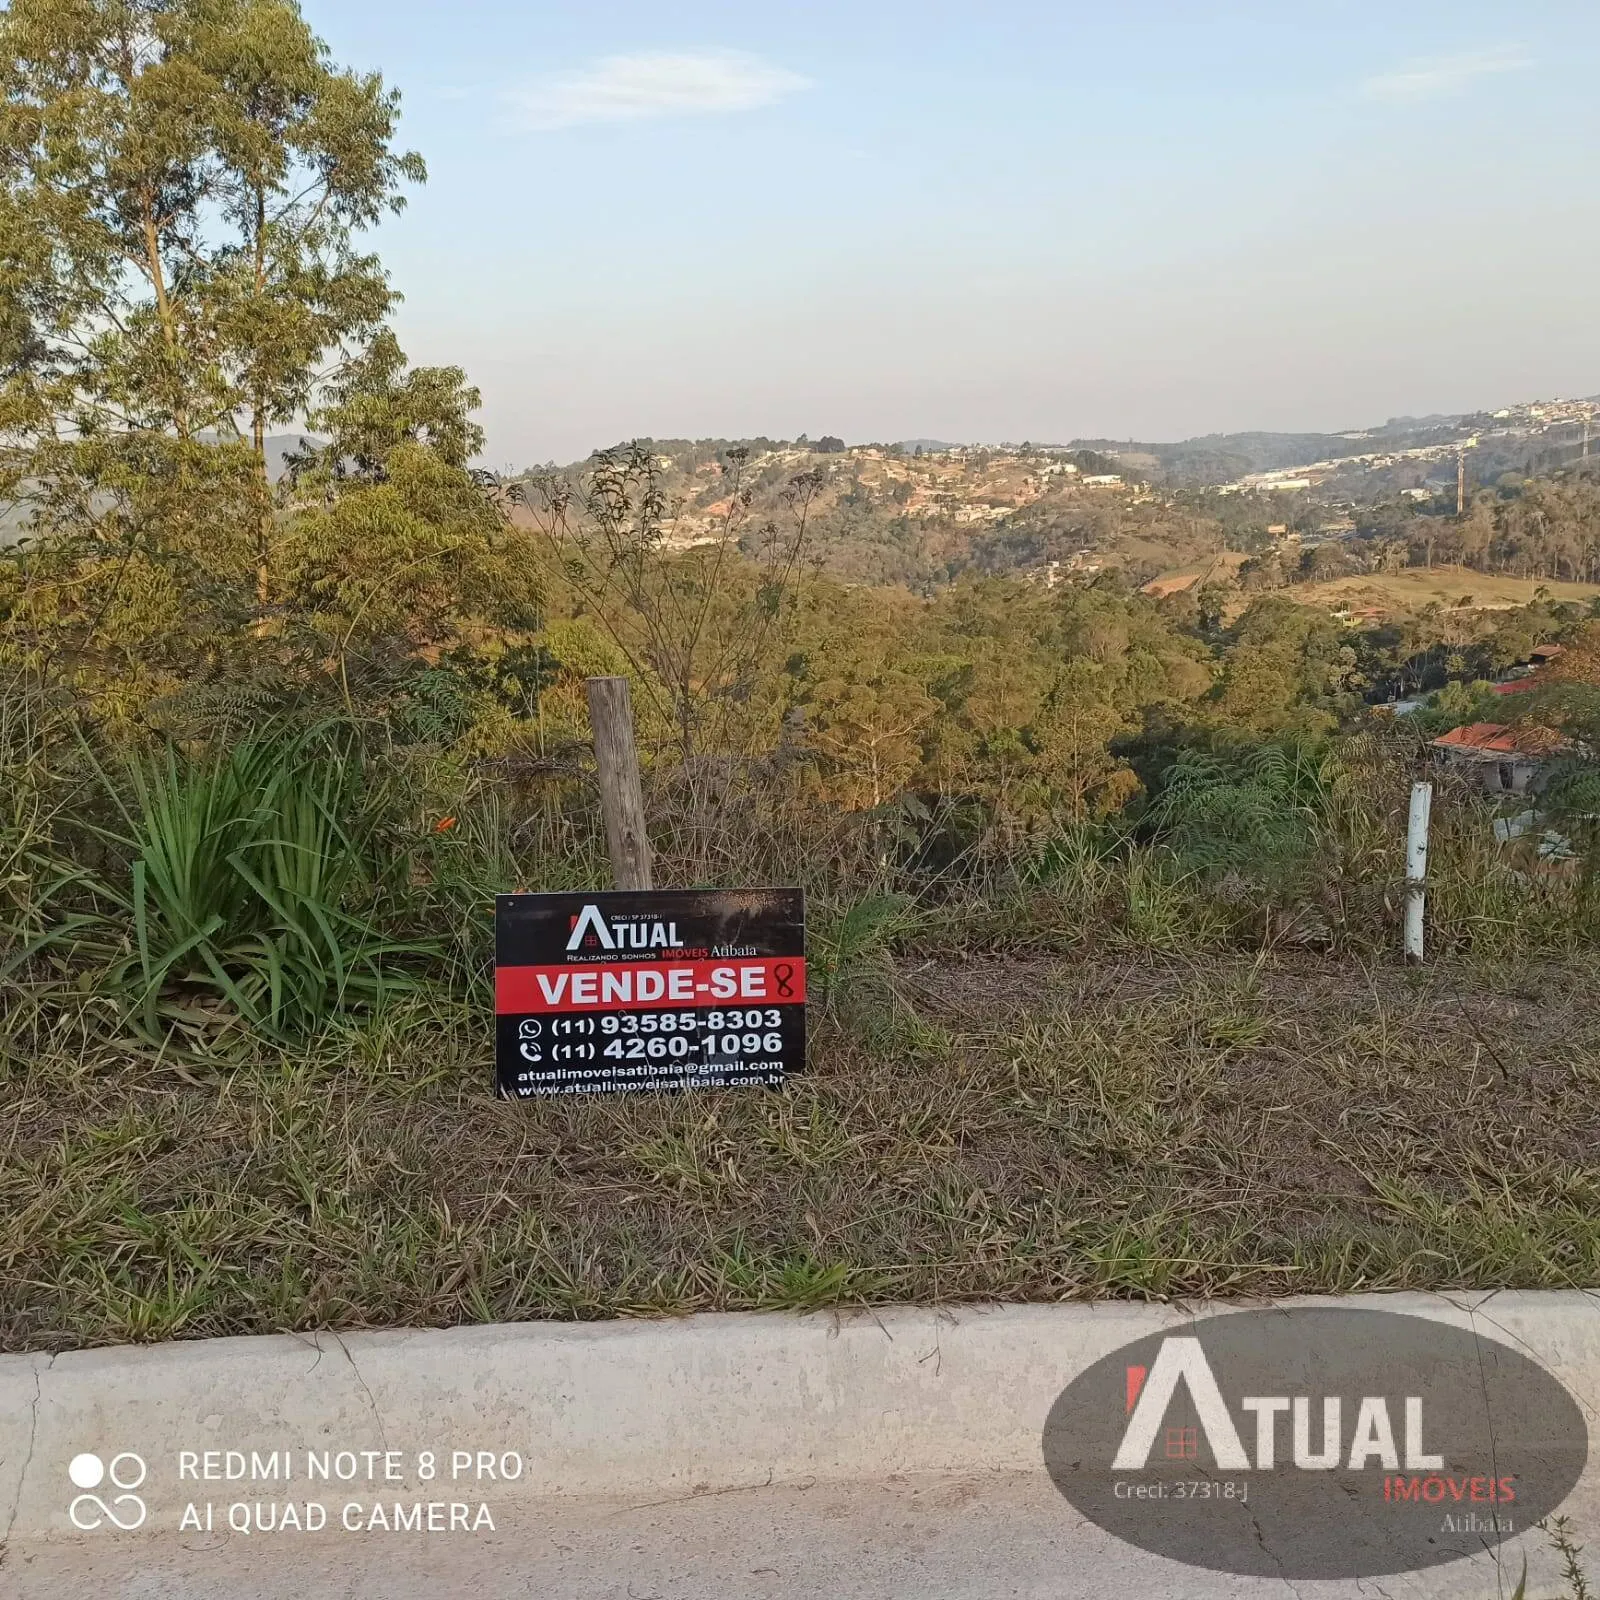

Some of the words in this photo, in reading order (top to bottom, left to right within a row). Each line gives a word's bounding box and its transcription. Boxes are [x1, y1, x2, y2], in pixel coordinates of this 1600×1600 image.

[566, 904, 683, 951] ATUAL
[566, 953, 618, 962] REALIZANDO
[621, 952, 656, 960] SONHOS
[711, 944, 757, 958] Atibaia
[536, 966, 767, 1006] VENDE-SE
[551, 1017, 596, 1037] (11)
[600, 1009, 782, 1036] 93585-8303
[551, 1042, 596, 1062] (11)
[603, 1032, 783, 1060] 4260-1096
[517, 1059, 784, 1082] atualimoveisatibaia@gmail.com
[518, 1073, 786, 1097] www.atualimoveisatibaia.com.br
